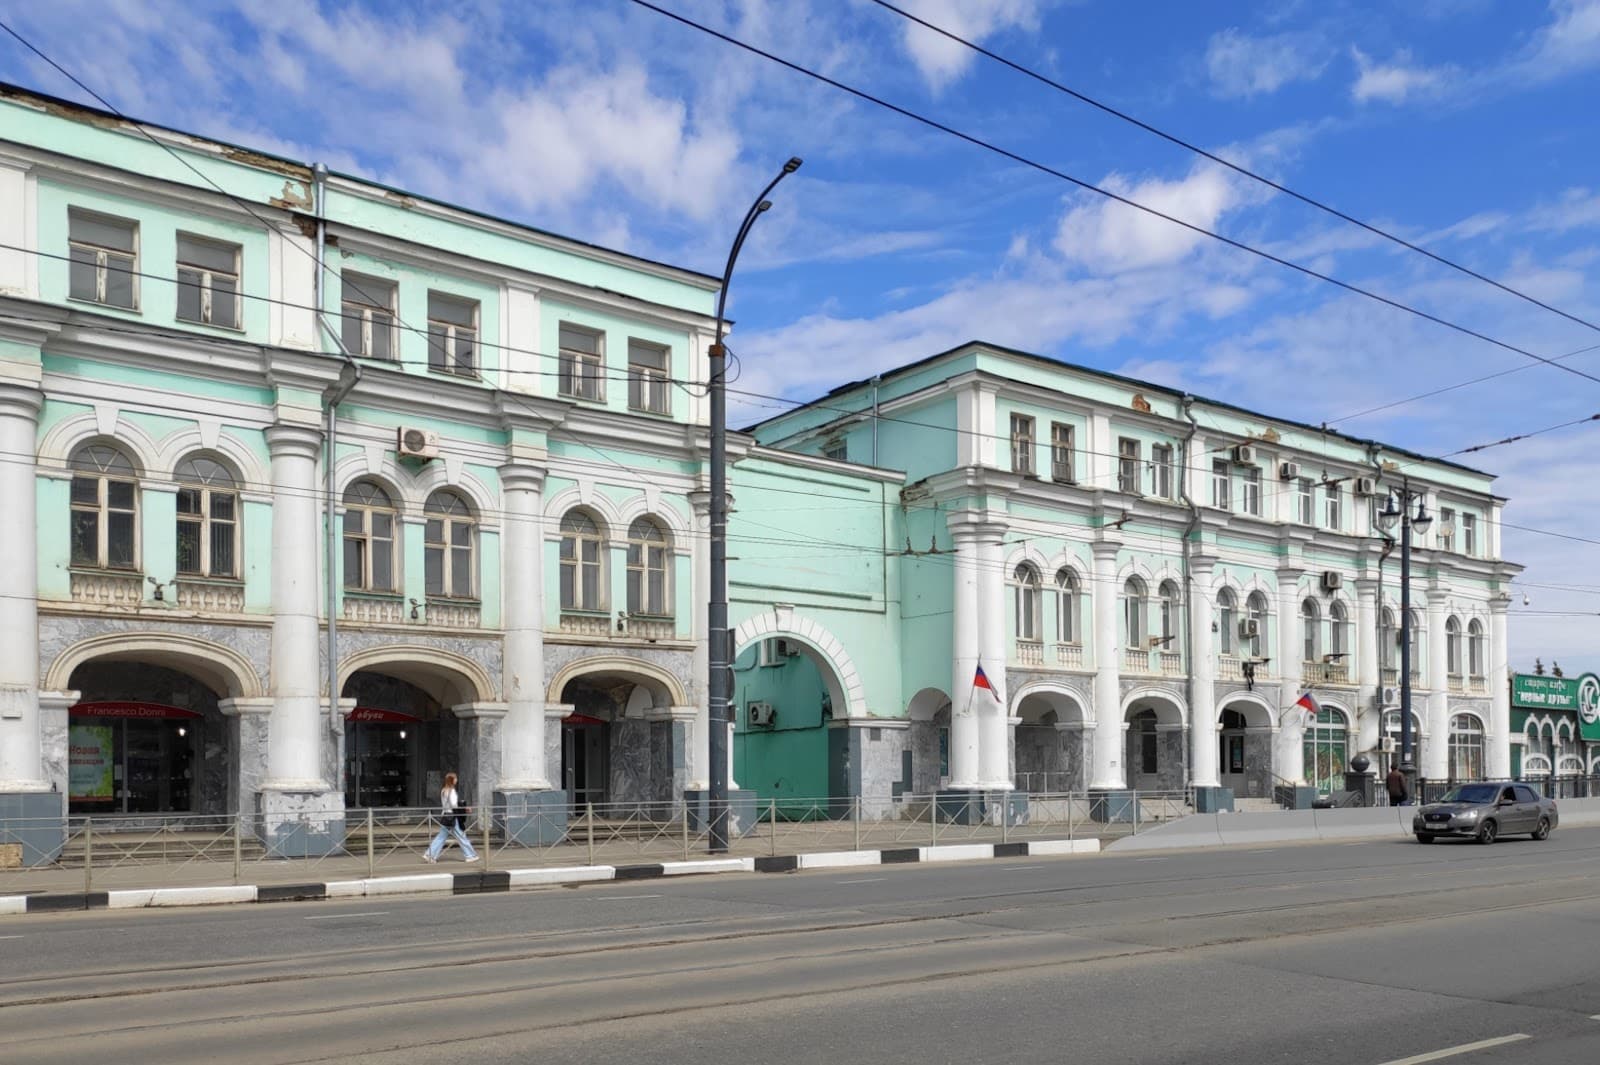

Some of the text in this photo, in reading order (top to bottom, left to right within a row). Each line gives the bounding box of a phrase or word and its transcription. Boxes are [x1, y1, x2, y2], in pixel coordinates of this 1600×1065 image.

[87, 706, 167, 717] Francesco Donni
[357, 710, 384, 720] обуви
